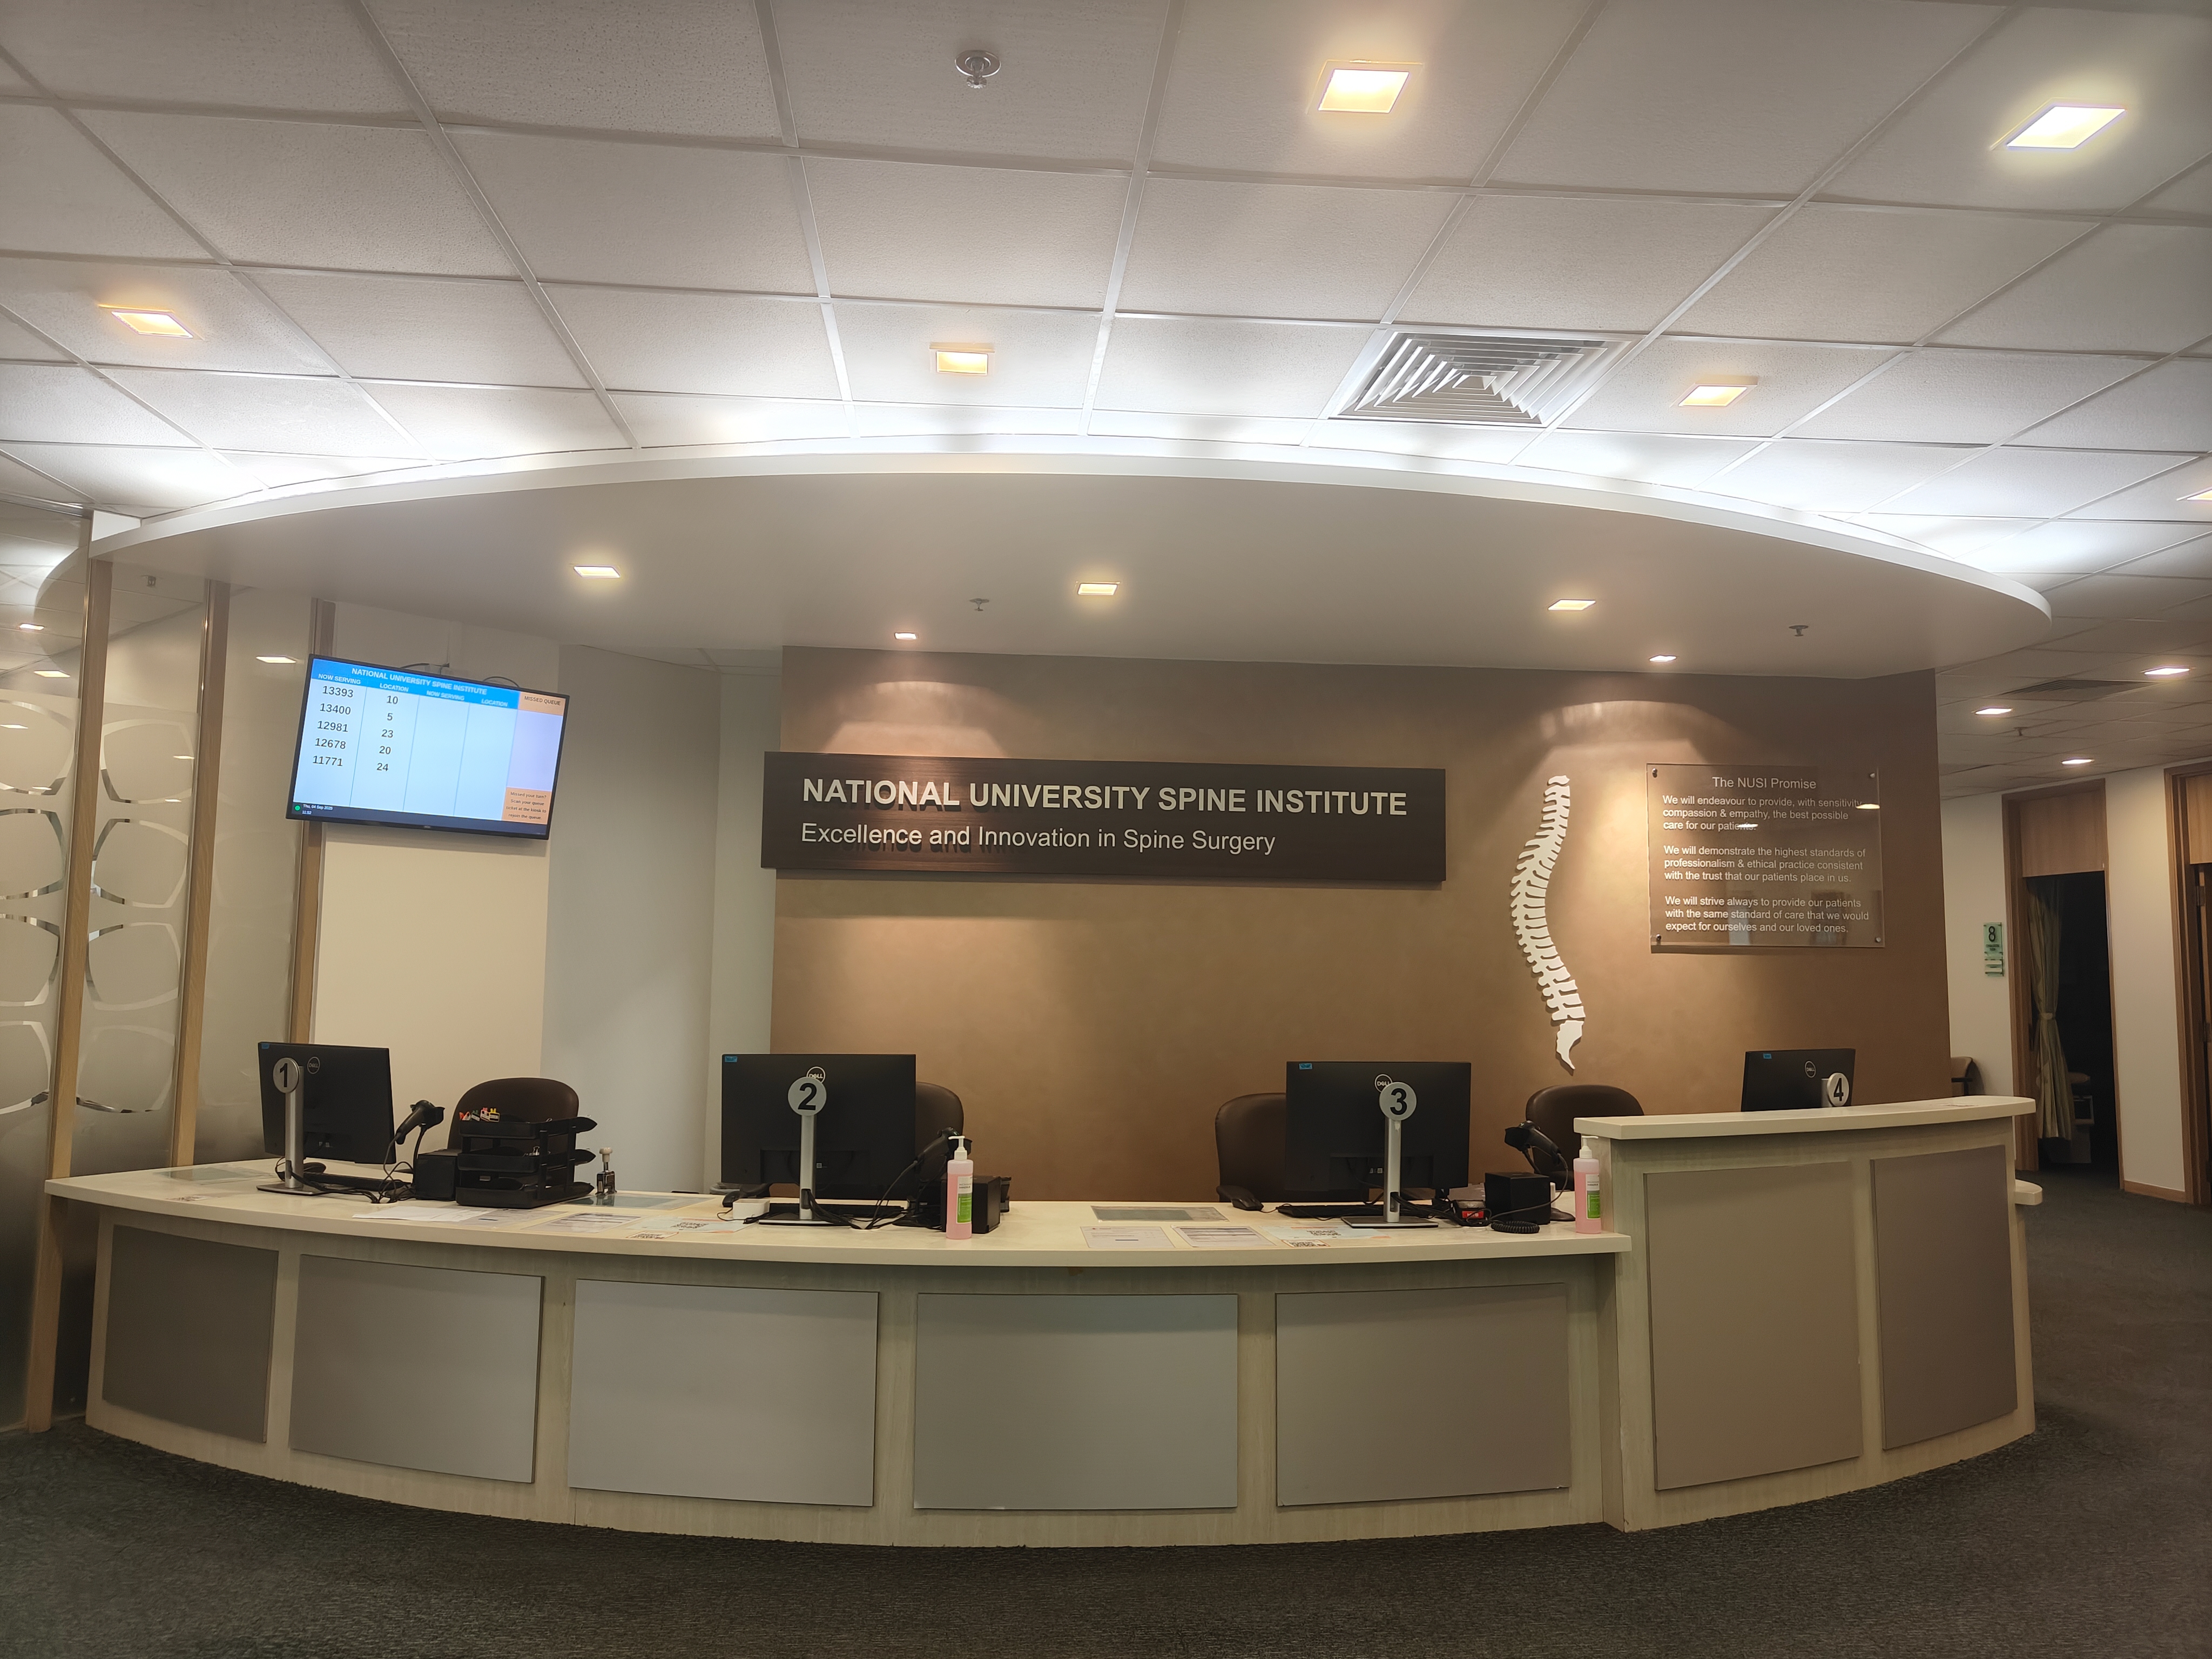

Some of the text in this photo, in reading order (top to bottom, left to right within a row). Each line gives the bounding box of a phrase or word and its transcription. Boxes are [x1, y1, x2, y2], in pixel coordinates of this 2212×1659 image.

[334, 676, 361, 685] SERVING
[352, 668, 487, 695] NATIONAL UNIVERSITY SPINE INSTITUTE
[322, 685, 354, 698] 13393
[380, 683, 409, 692] LOCATION
[386, 695, 398, 704] 10
[440, 692, 464, 700] SERVING
[482, 698, 508, 707] LOCATION
[320, 703, 351, 714] 13400
[387, 712, 393, 721] 5
[317, 720, 348, 732] 12981
[381, 729, 393, 738] 23
[315, 738, 346, 749] 12678
[379, 746, 391, 754] 20
[312, 755, 343, 766] 11771
[376, 763, 388, 771] 24
[1712, 777, 1816, 789] The NUSI Promise
[803, 778, 1407, 815] NATIONAL UNIVERSITY SPINE INSTITUTE
[1662, 795, 1678, 804] We
[1681, 795, 1695, 804] will
[1697, 796, 1745, 805] endeavour
[1748, 797, 1756, 805] to
[1759, 798, 1795, 807] provide,
[1798, 798, 1815, 806] with
[1663, 809, 1717, 818] compassion
[1720, 809, 1727, 818] &
[1729, 810, 1770, 820] empathy,
[1790, 811, 1809, 819] best
[1811, 811, 1849, 820] possible
[1685, 821, 1698, 830] for
[801, 822, 1276, 855] Excellence and Innovation in Spine Surgery
[1663, 845, 1866, 858] We will demonstrate the highest standards of
[1664, 858, 1863, 870] professionalism & ethical practice consistent
[1664, 871, 1683, 880] with
[1685, 871, 1700, 880] the
[1702, 872, 1723, 880] trust
[1725, 872, 1742, 880] that
[1762, 873, 1798, 882] patients
[1800, 873, 1824, 883] place
[1827, 874, 1835, 882] in
[1665, 896, 1681, 905] We
[1683, 896, 1697, 905] will
[1700, 896, 1724, 906] strive
[1727, 897, 1758, 908] always
[1761, 898, 1770, 906] to
[1772, 898, 1805, 908] provide
[1826, 899, 1861, 908] patients
[1665, 909, 1684, 918] with
[1687, 909, 1701, 918] the
[1731, 910, 1770, 919] standard
[1773, 911, 1783, 919] of
[1807, 911, 1824, 919] that
[1842, 912, 1869, 920] would
[1665, 922, 1697, 932] expect
[1698, 922, 1711, 930] for
[1713, 922, 1757, 931] ourselves
[1759, 923, 1777, 932] and
[1797, 923, 1821, 932] loved
[1988, 926, 1995, 942] 8
[280, 1063, 288, 1088] 1
[1833, 1077, 1844, 1102] 4
[798, 1083, 817, 1110] 2
[1390, 1088, 1407, 1115] 3
